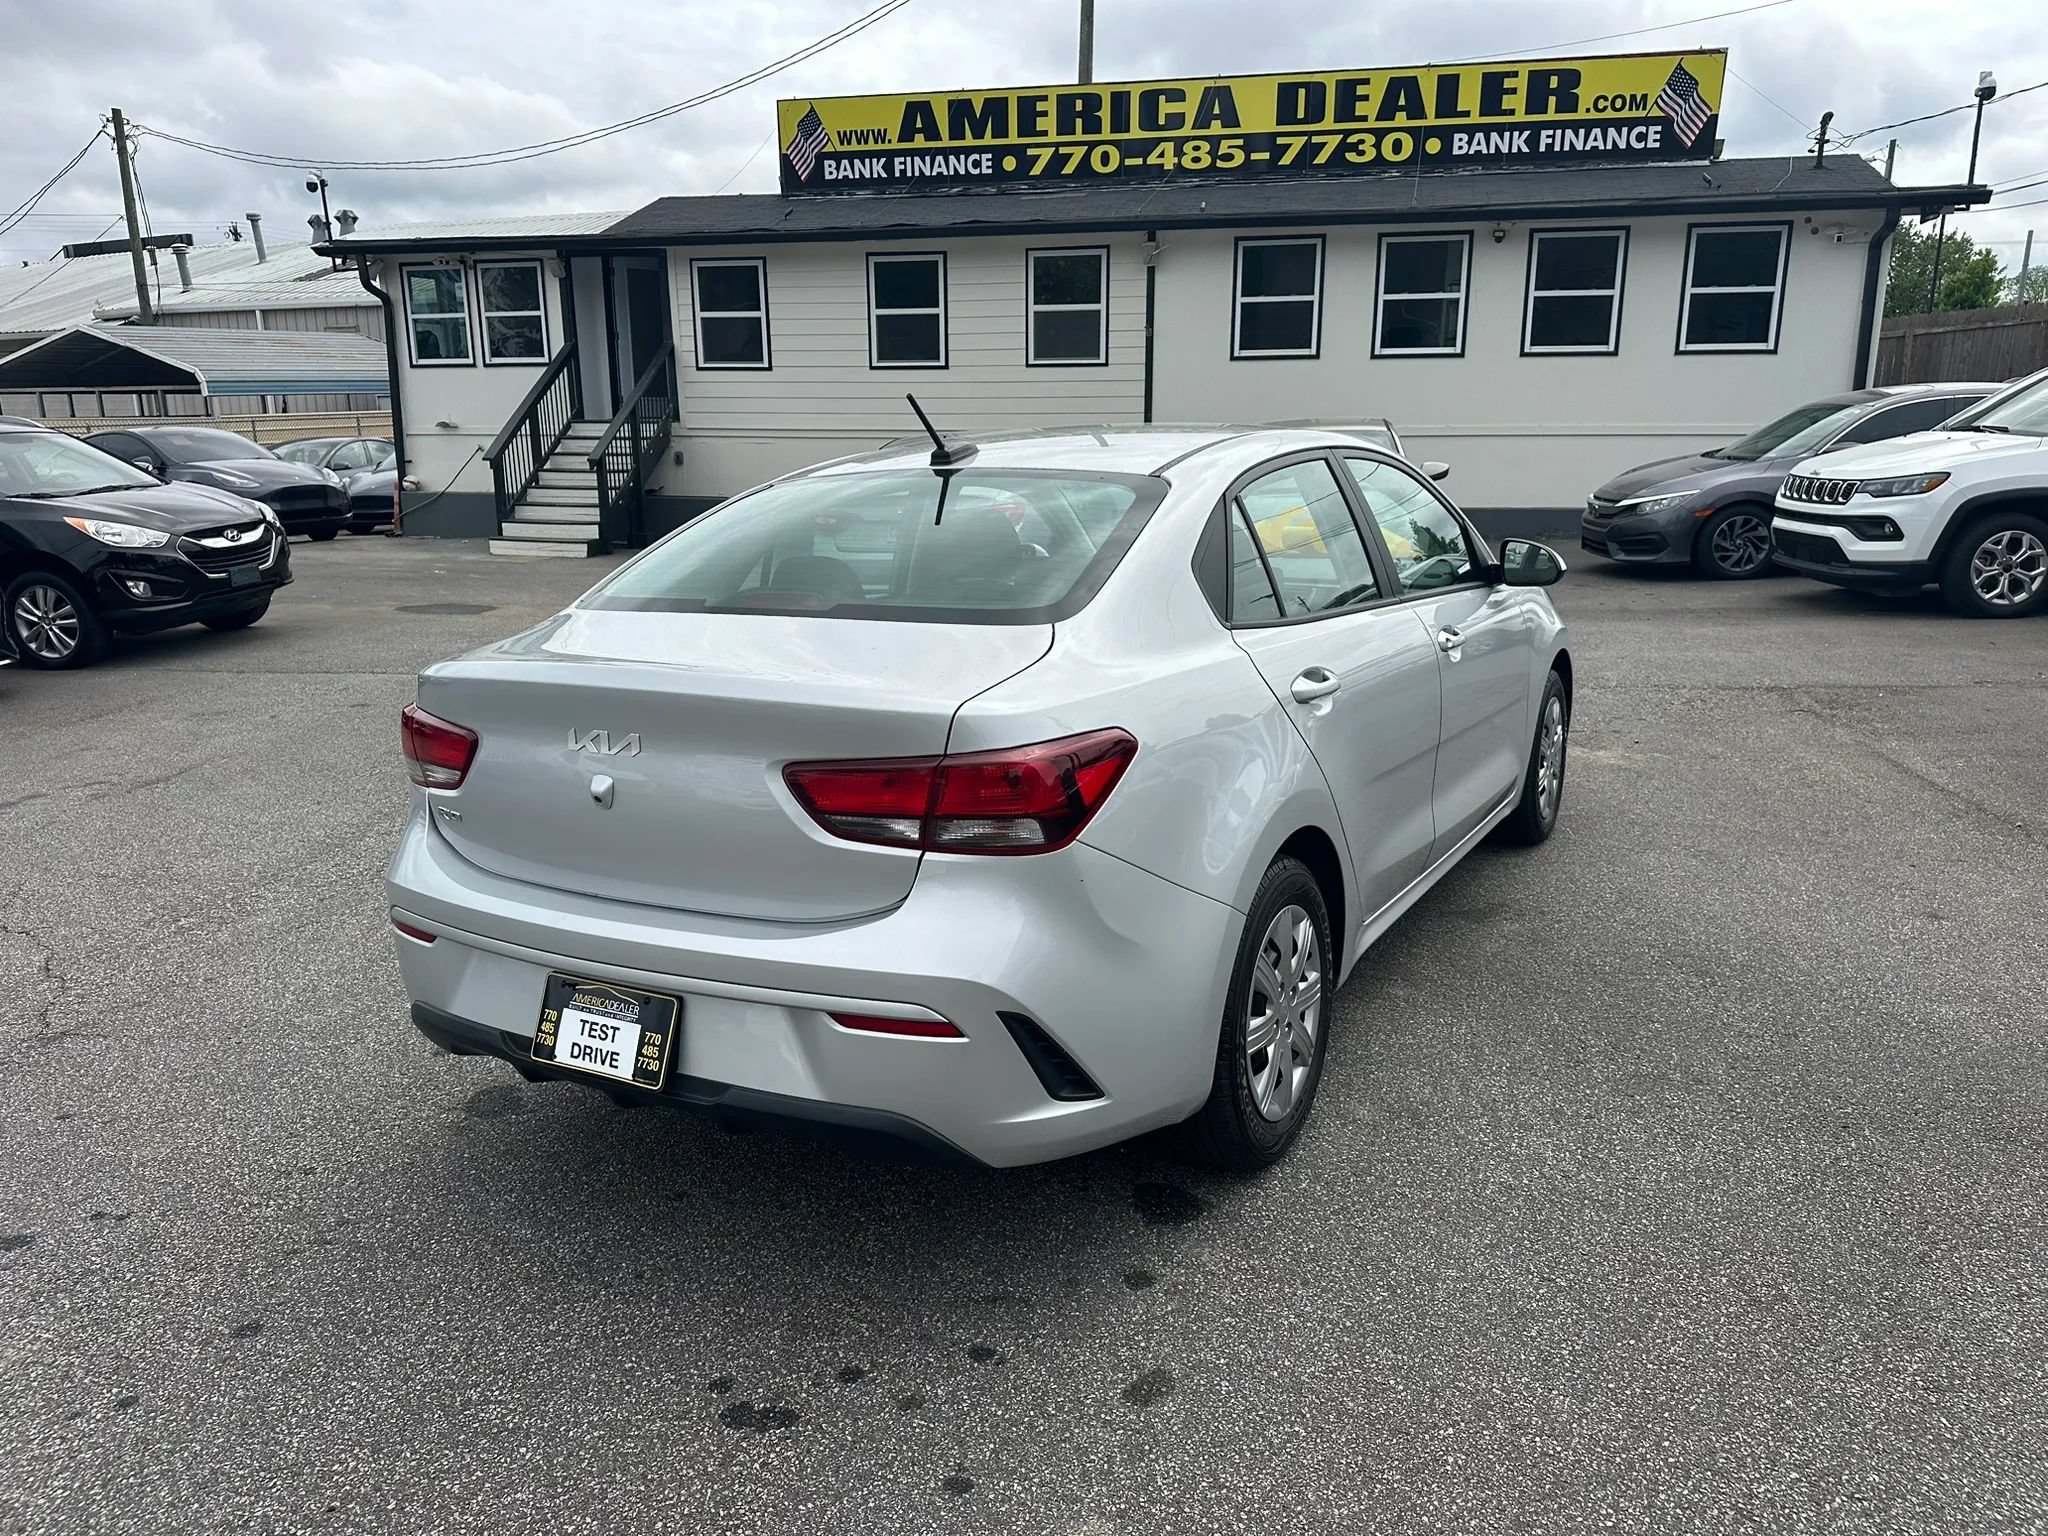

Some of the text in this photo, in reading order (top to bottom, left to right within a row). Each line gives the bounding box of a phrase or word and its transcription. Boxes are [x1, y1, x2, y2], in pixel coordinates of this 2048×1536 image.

[896, 84, 1241, 143] AMERICA
[1275, 68, 1582, 126] DEALER
[823, 125, 1662, 180] BANK FINANCE 770-485-7730 BANK FINANCE
[567, 727, 641, 758] KIA
[543, 1008, 558, 1021] 770
[540, 1021, 555, 1034] 485
[579, 1018, 620, 1044] TEST
[536, 1032, 555, 1047] 7730
[644, 1031, 662, 1046] 770
[570, 1041, 620, 1069] DRIVE
[641, 1044, 659, 1058] 485
[637, 1056, 660, 1072] 7730
